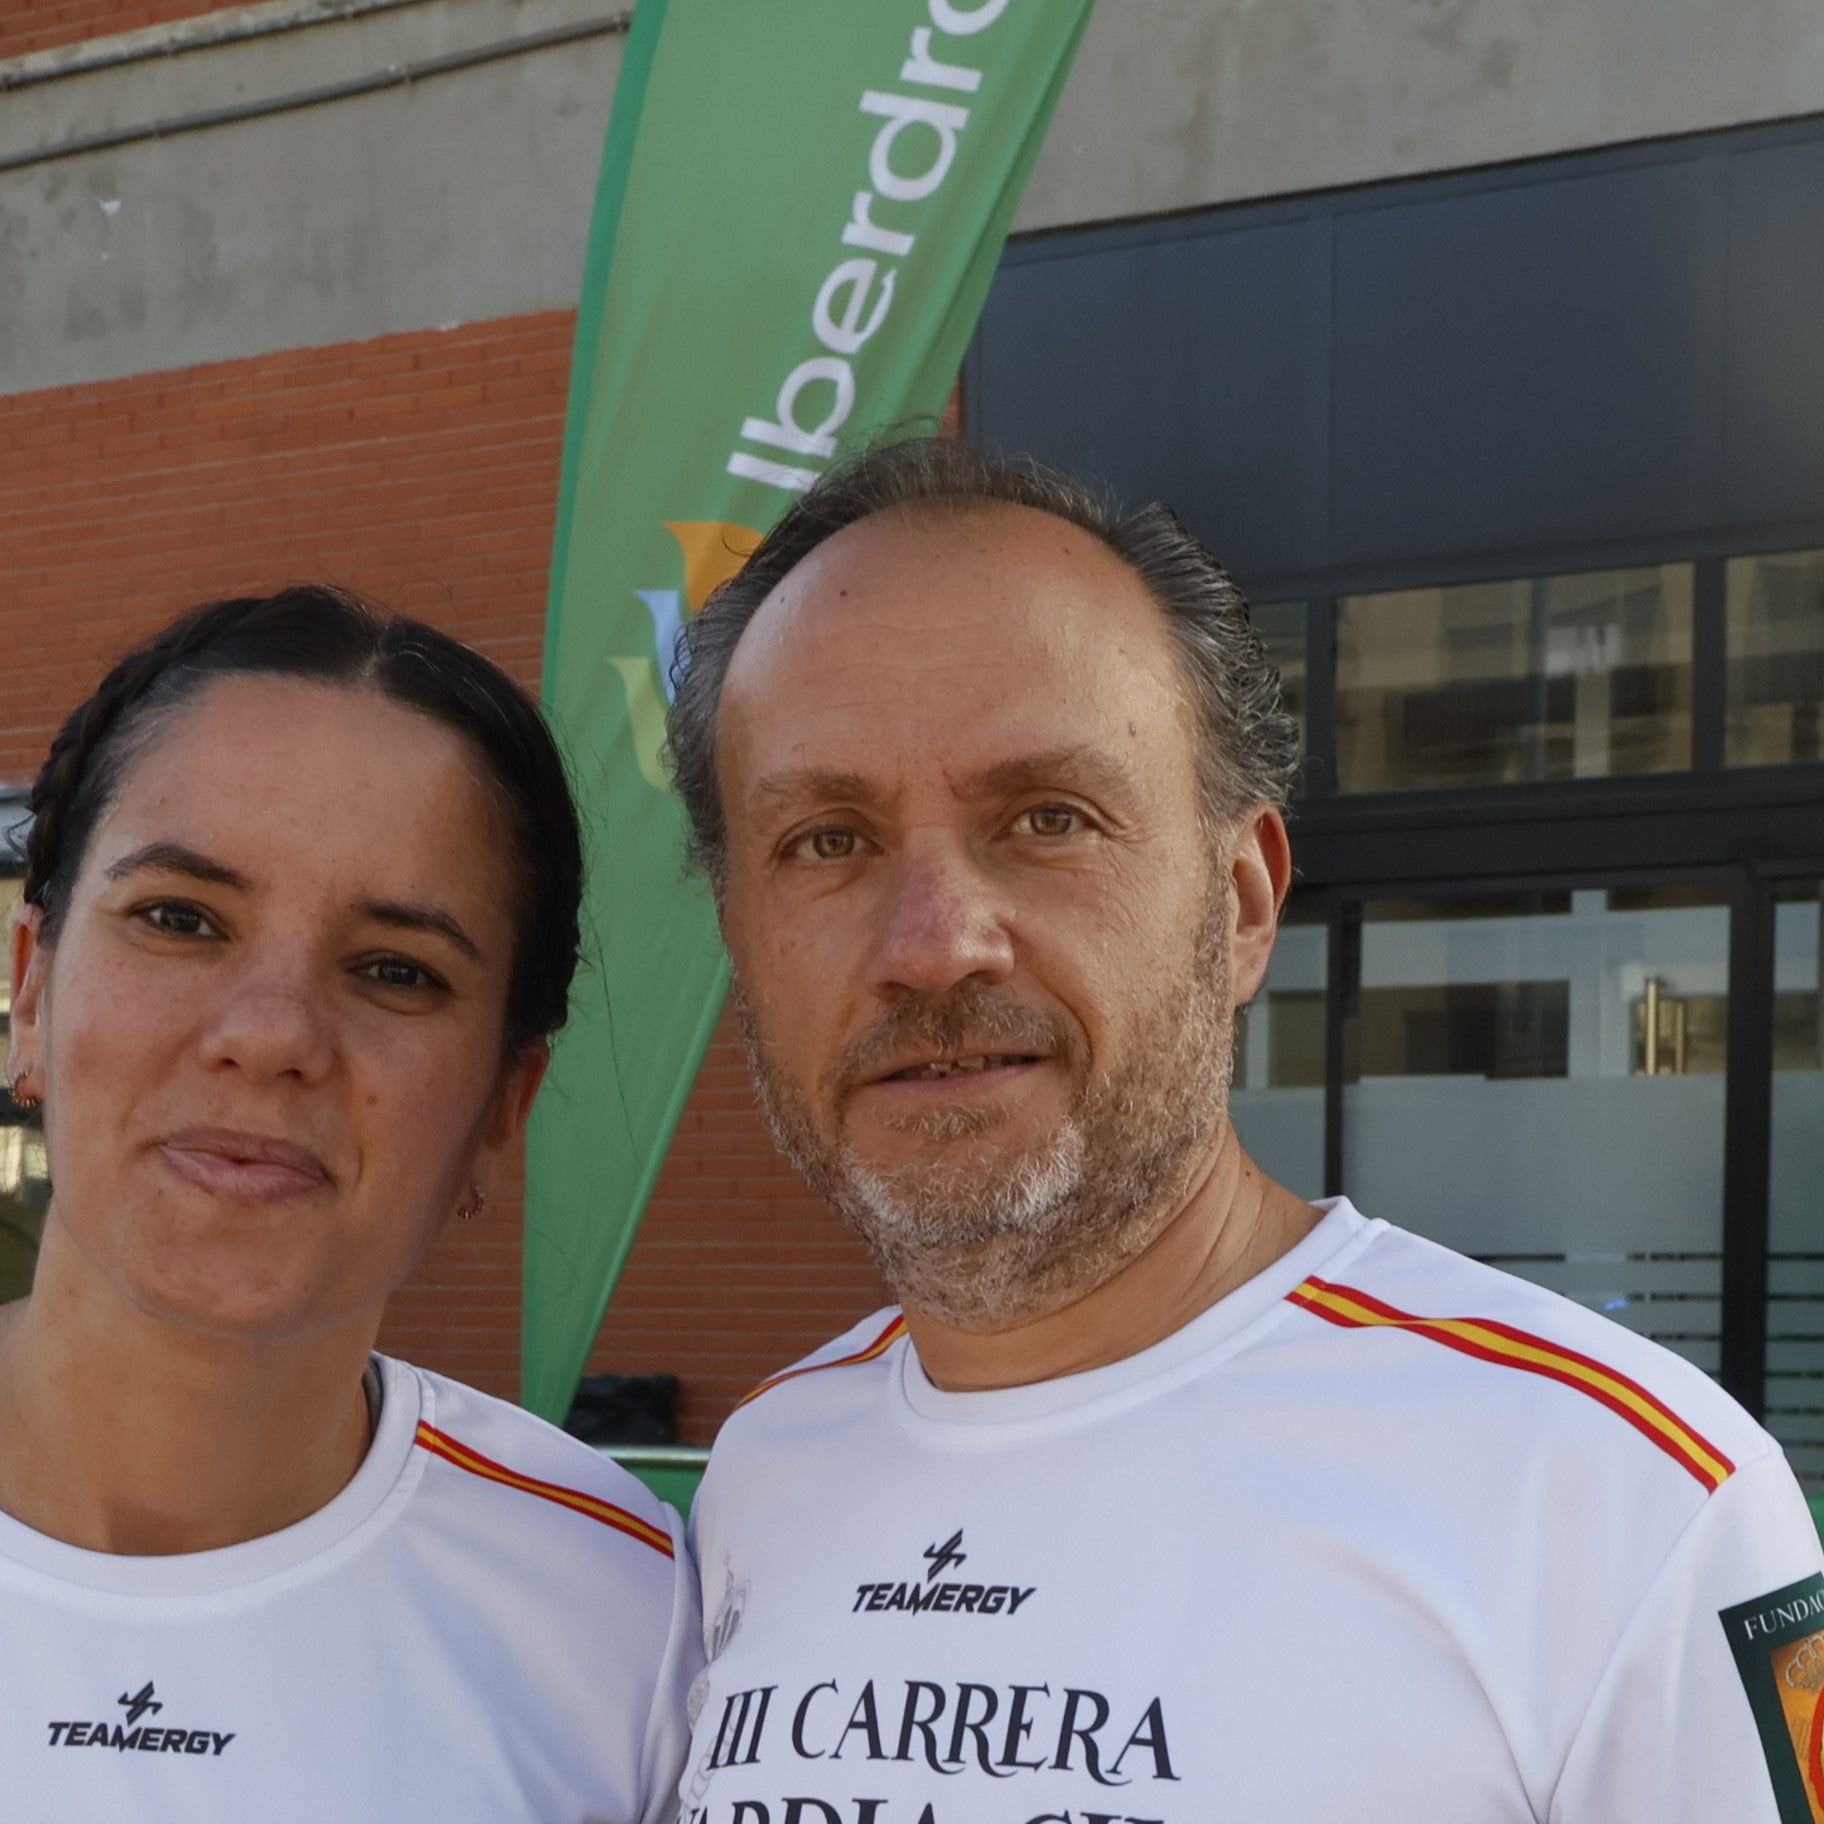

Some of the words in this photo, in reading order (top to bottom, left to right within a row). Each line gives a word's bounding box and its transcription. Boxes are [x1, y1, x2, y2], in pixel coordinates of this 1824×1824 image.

[726, 0, 1009, 491] Iberdr
[852, 1583, 1036, 1615] TEAMERGY
[47, 1721, 235, 1756] TEAMERGY
[707, 1685, 779, 1771] III
[791, 1678, 1181, 1786] CARRERA
